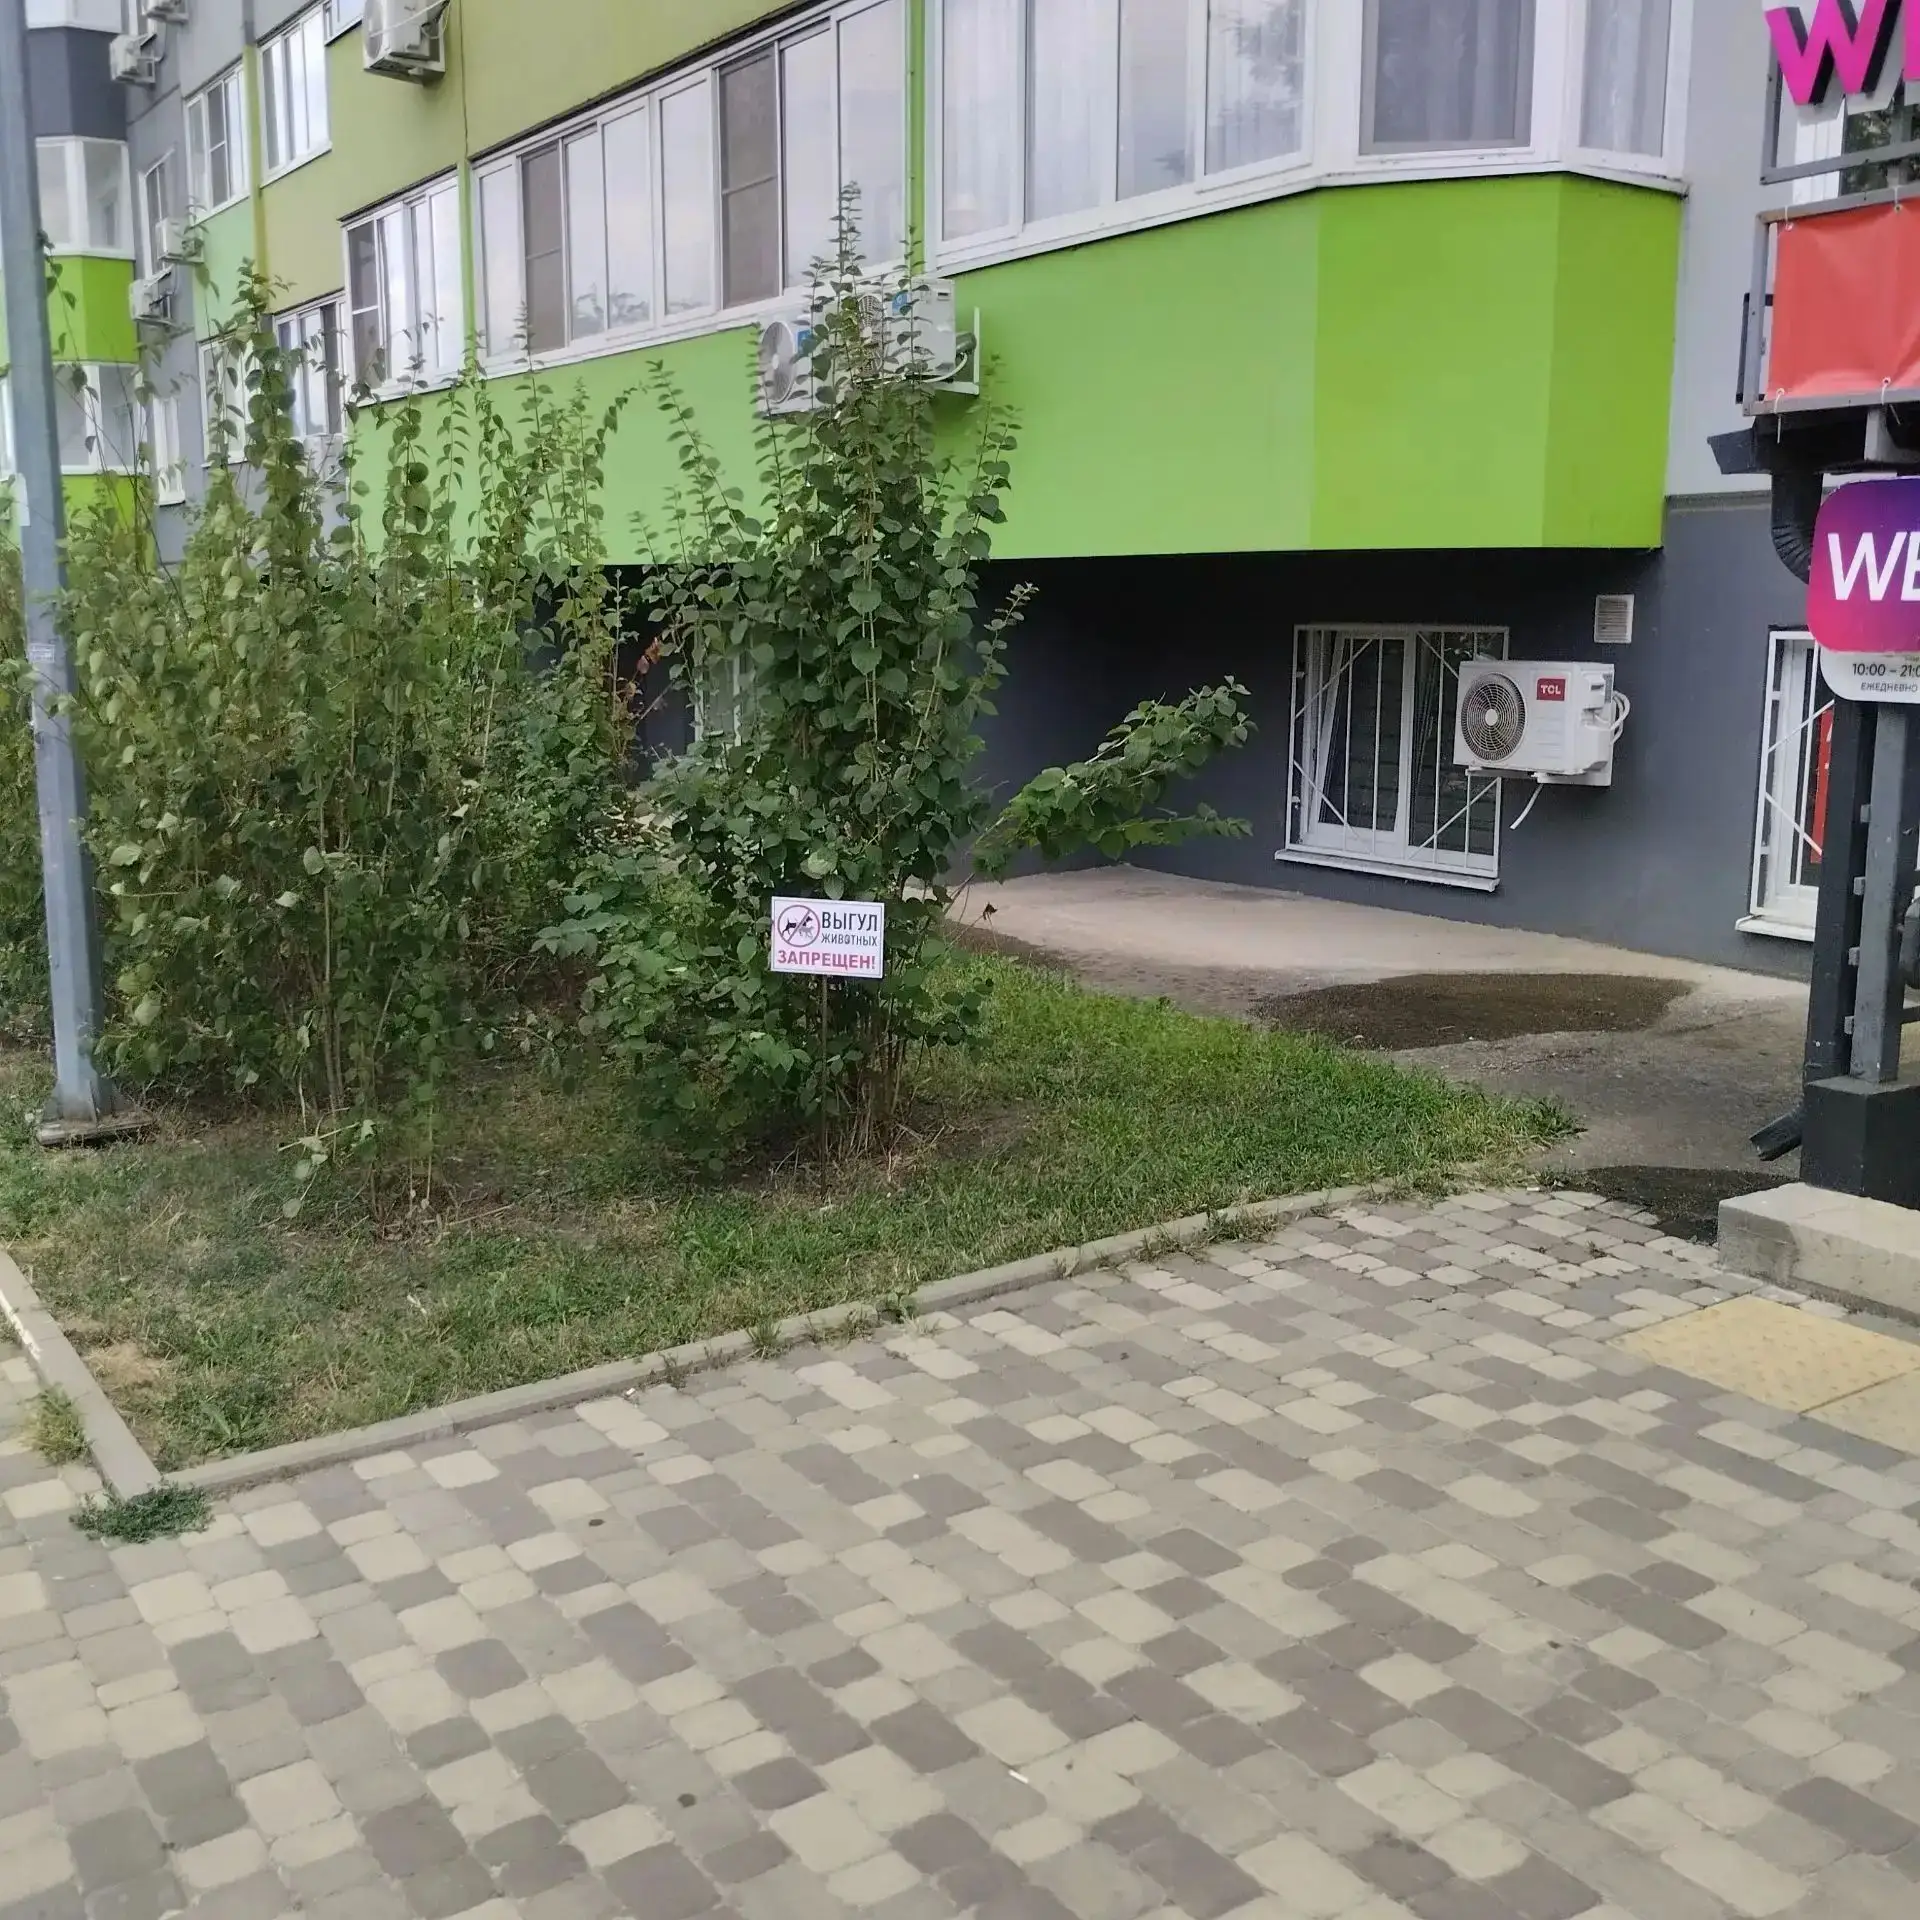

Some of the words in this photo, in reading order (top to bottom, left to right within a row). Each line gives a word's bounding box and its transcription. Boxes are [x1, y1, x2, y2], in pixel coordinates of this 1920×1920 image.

[1852, 663, 1886, 676] 10:00
[1540, 684, 1561, 695] TCL
[1860, 682, 1918, 693] ЕЖЕДНЕВНО
[821, 911, 878, 932] ВЫГУЛ
[777, 950, 876, 970] ЗАПРЕЩЕН!
